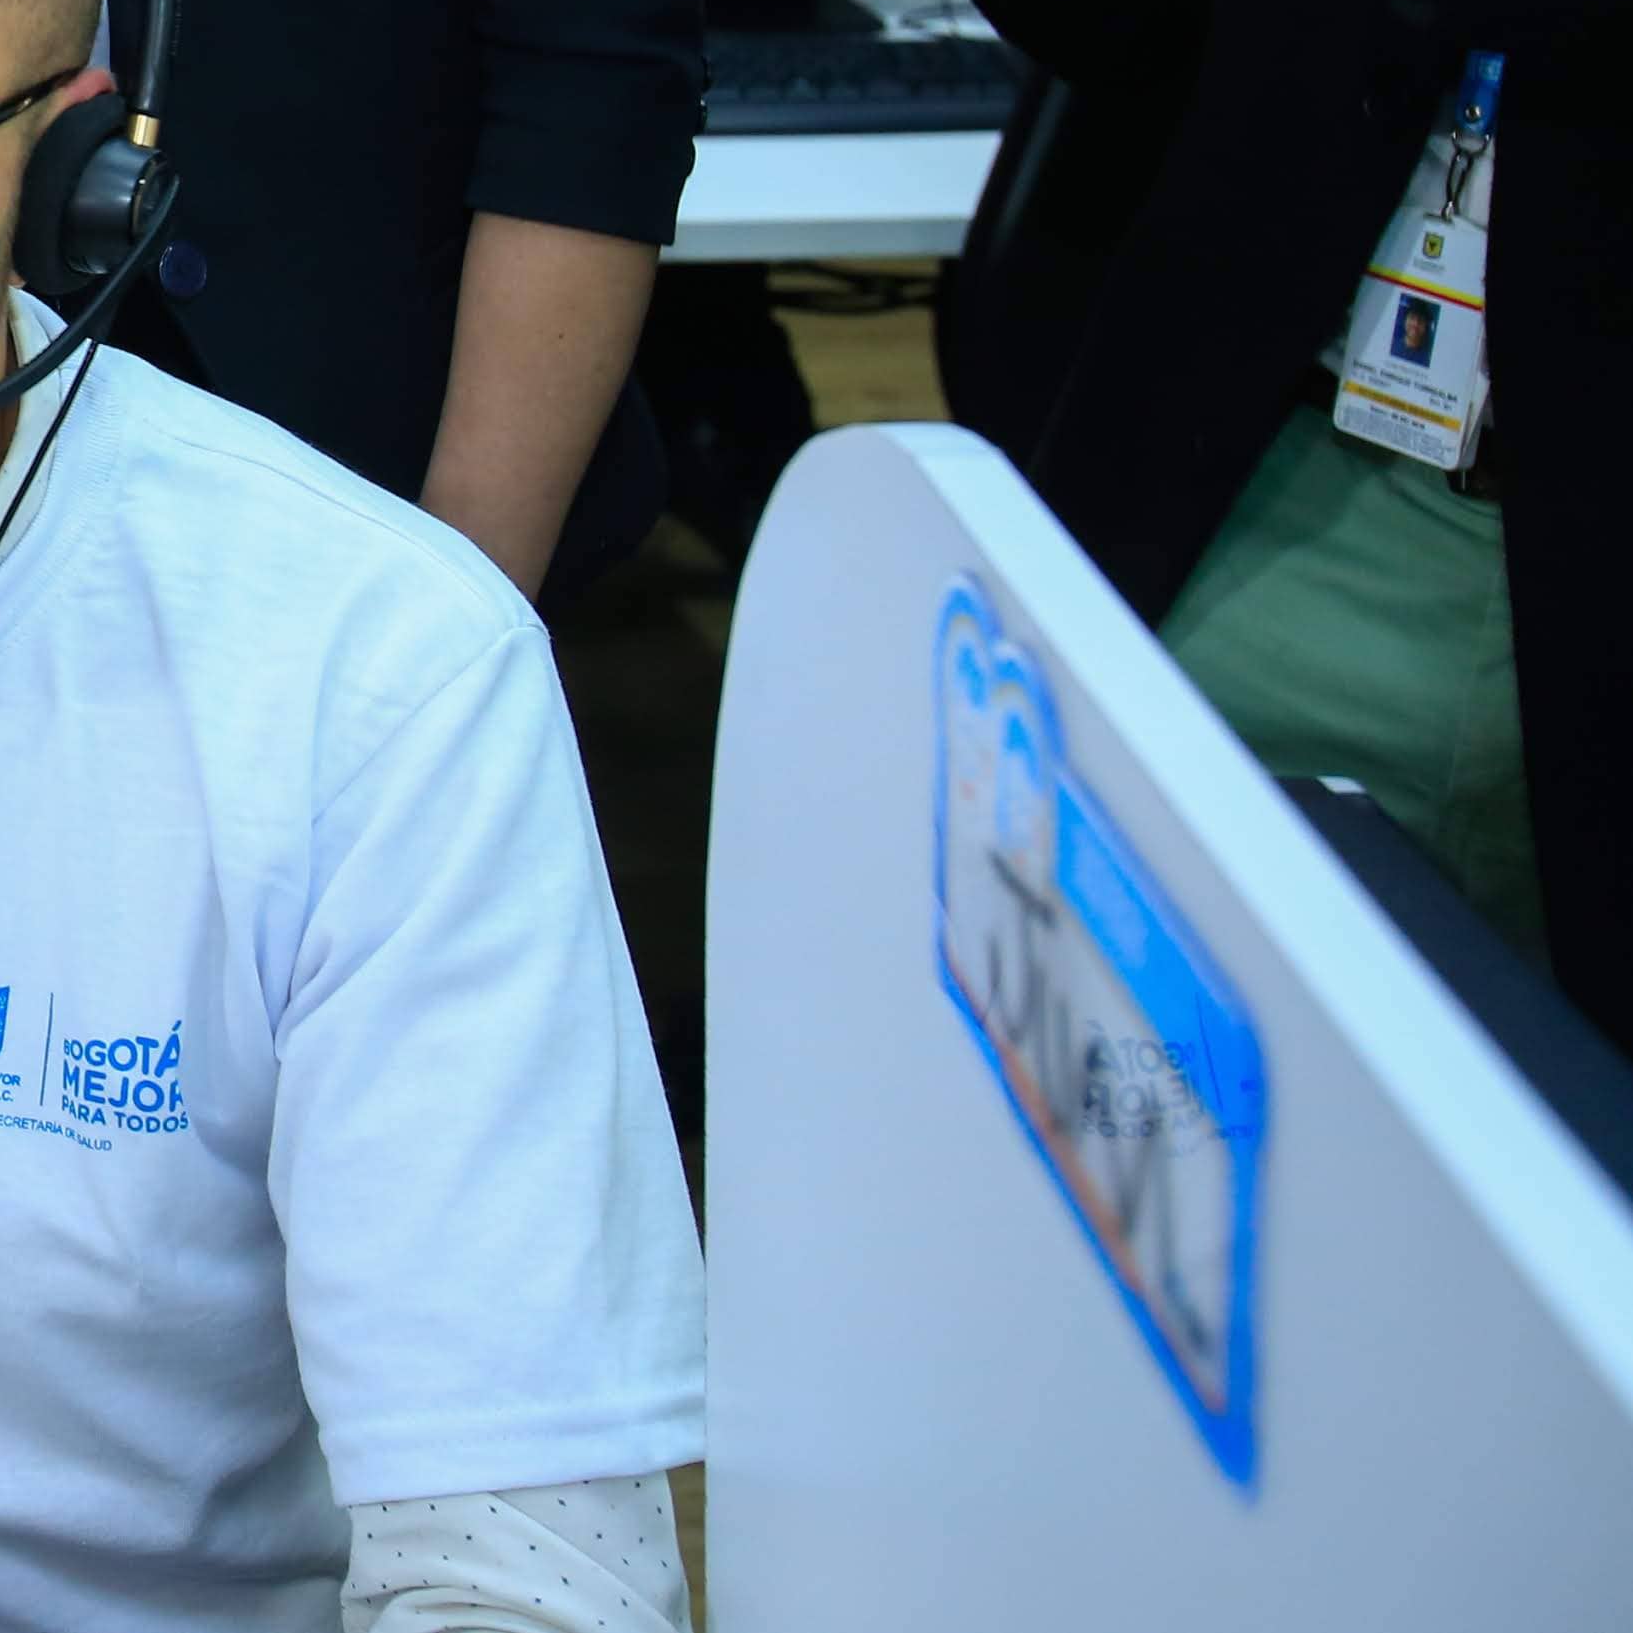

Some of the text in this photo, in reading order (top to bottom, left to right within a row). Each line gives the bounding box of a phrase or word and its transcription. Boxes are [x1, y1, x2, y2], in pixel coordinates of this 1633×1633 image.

[63, 1020, 183, 1079] BOGOTÁ
[61, 1094, 189, 1134] PARA TODOS
[65, 1126, 80, 1142] DE
